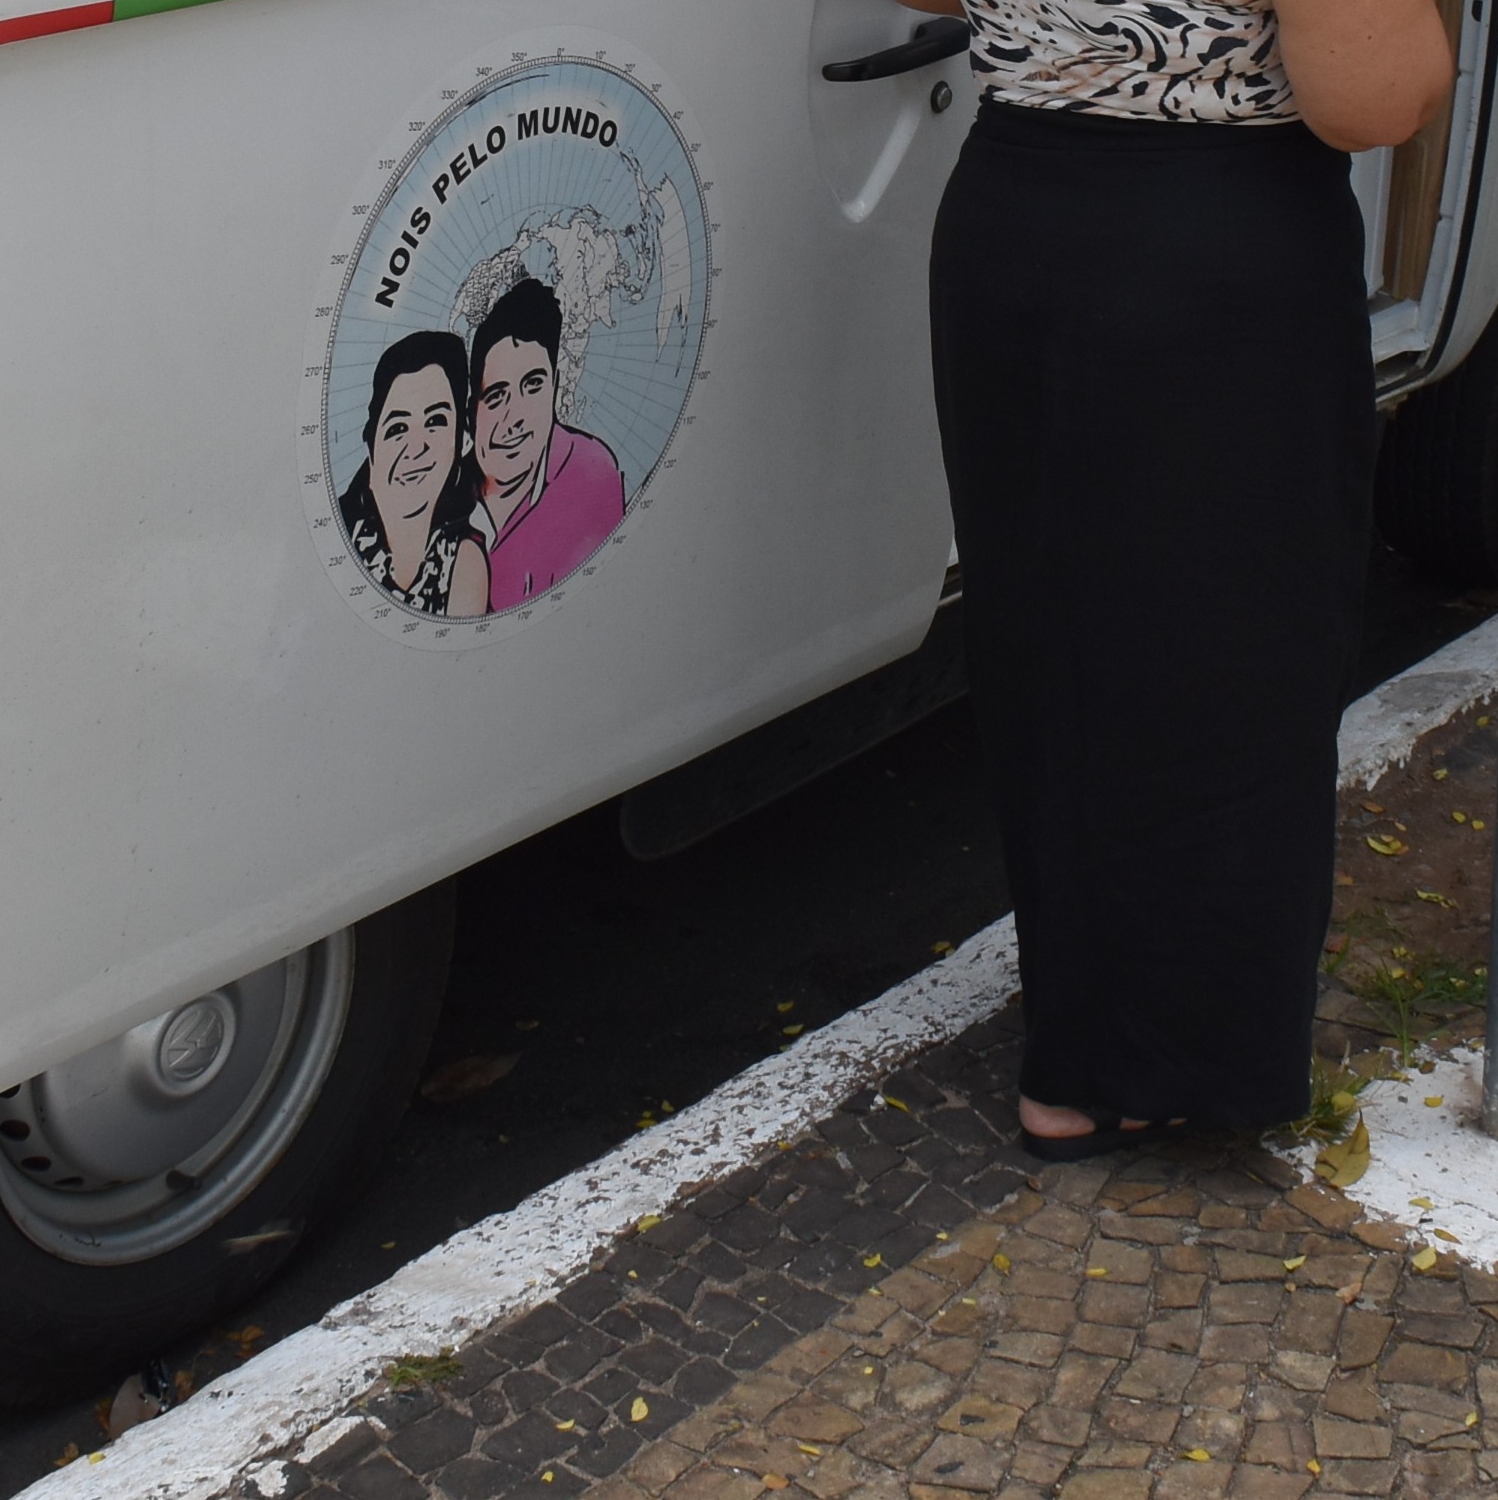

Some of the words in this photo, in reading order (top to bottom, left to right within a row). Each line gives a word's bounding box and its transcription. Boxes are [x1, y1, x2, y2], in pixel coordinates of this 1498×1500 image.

[375, 205, 431, 309] NOIS
[431, 125, 506, 205] PELO
[517, 106, 618, 148] MUNDO
